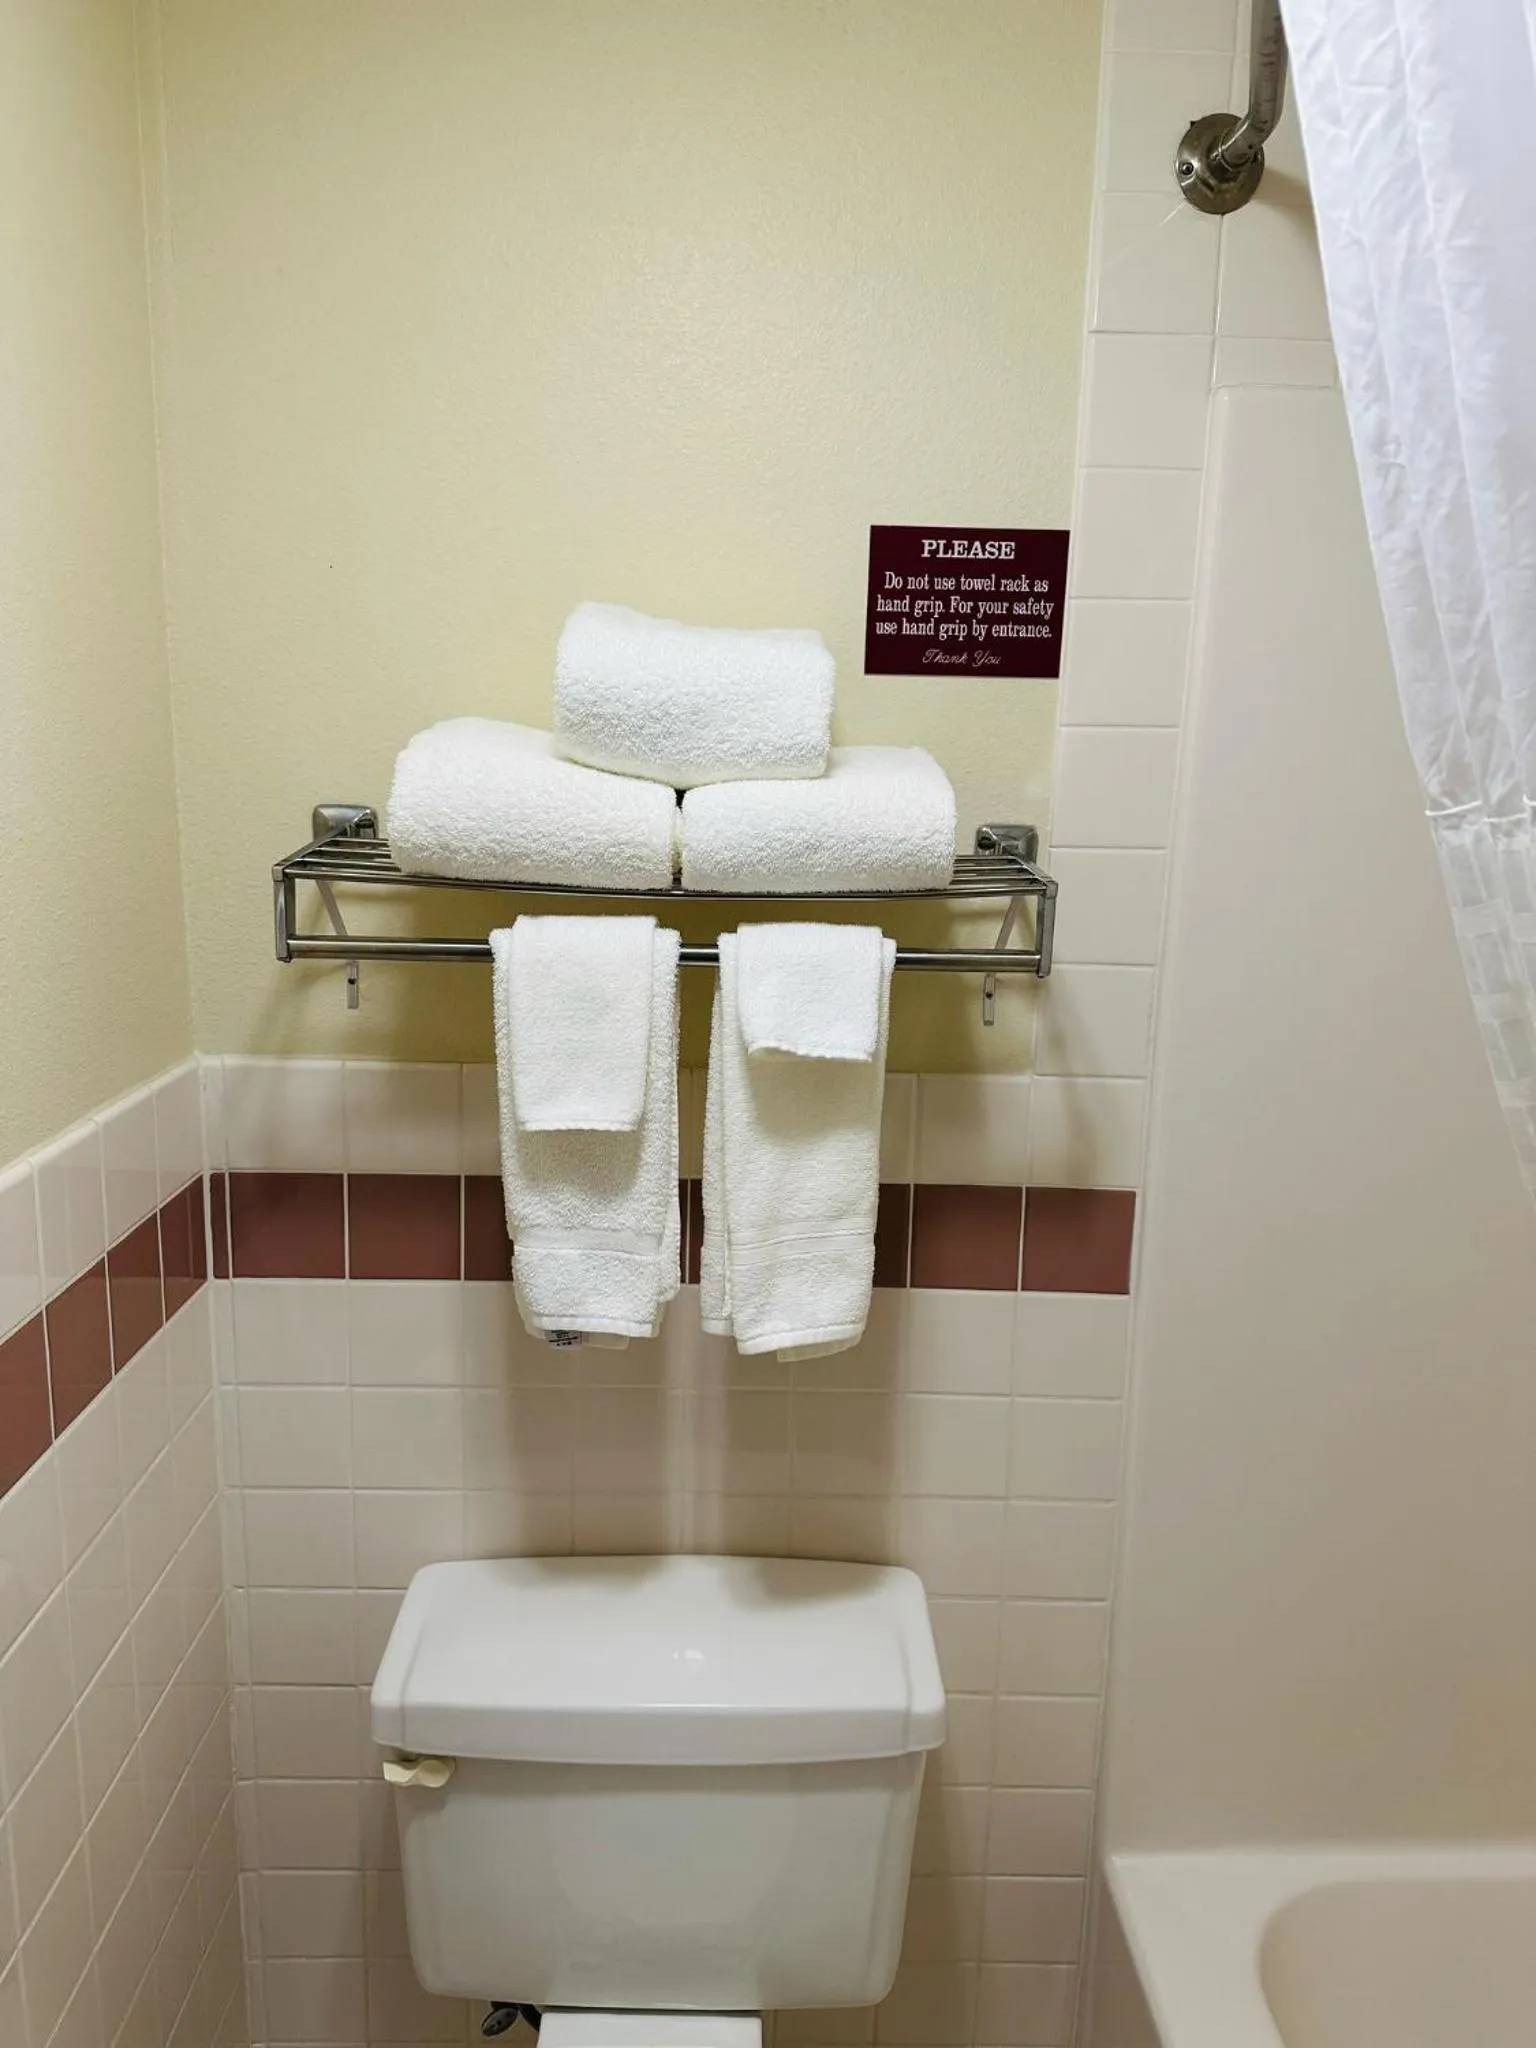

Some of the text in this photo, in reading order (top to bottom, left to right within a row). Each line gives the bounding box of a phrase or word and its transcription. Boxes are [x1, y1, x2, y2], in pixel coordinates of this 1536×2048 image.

[921, 539, 1015, 559] PLEASE
[885, 572, 1049, 592] Do not use towel rack as
[877, 595, 1054, 620] hand grip. For your safety
[876, 618, 1052, 640] use hand grip by entrance.
[922, 649, 1001, 667] Thank You
